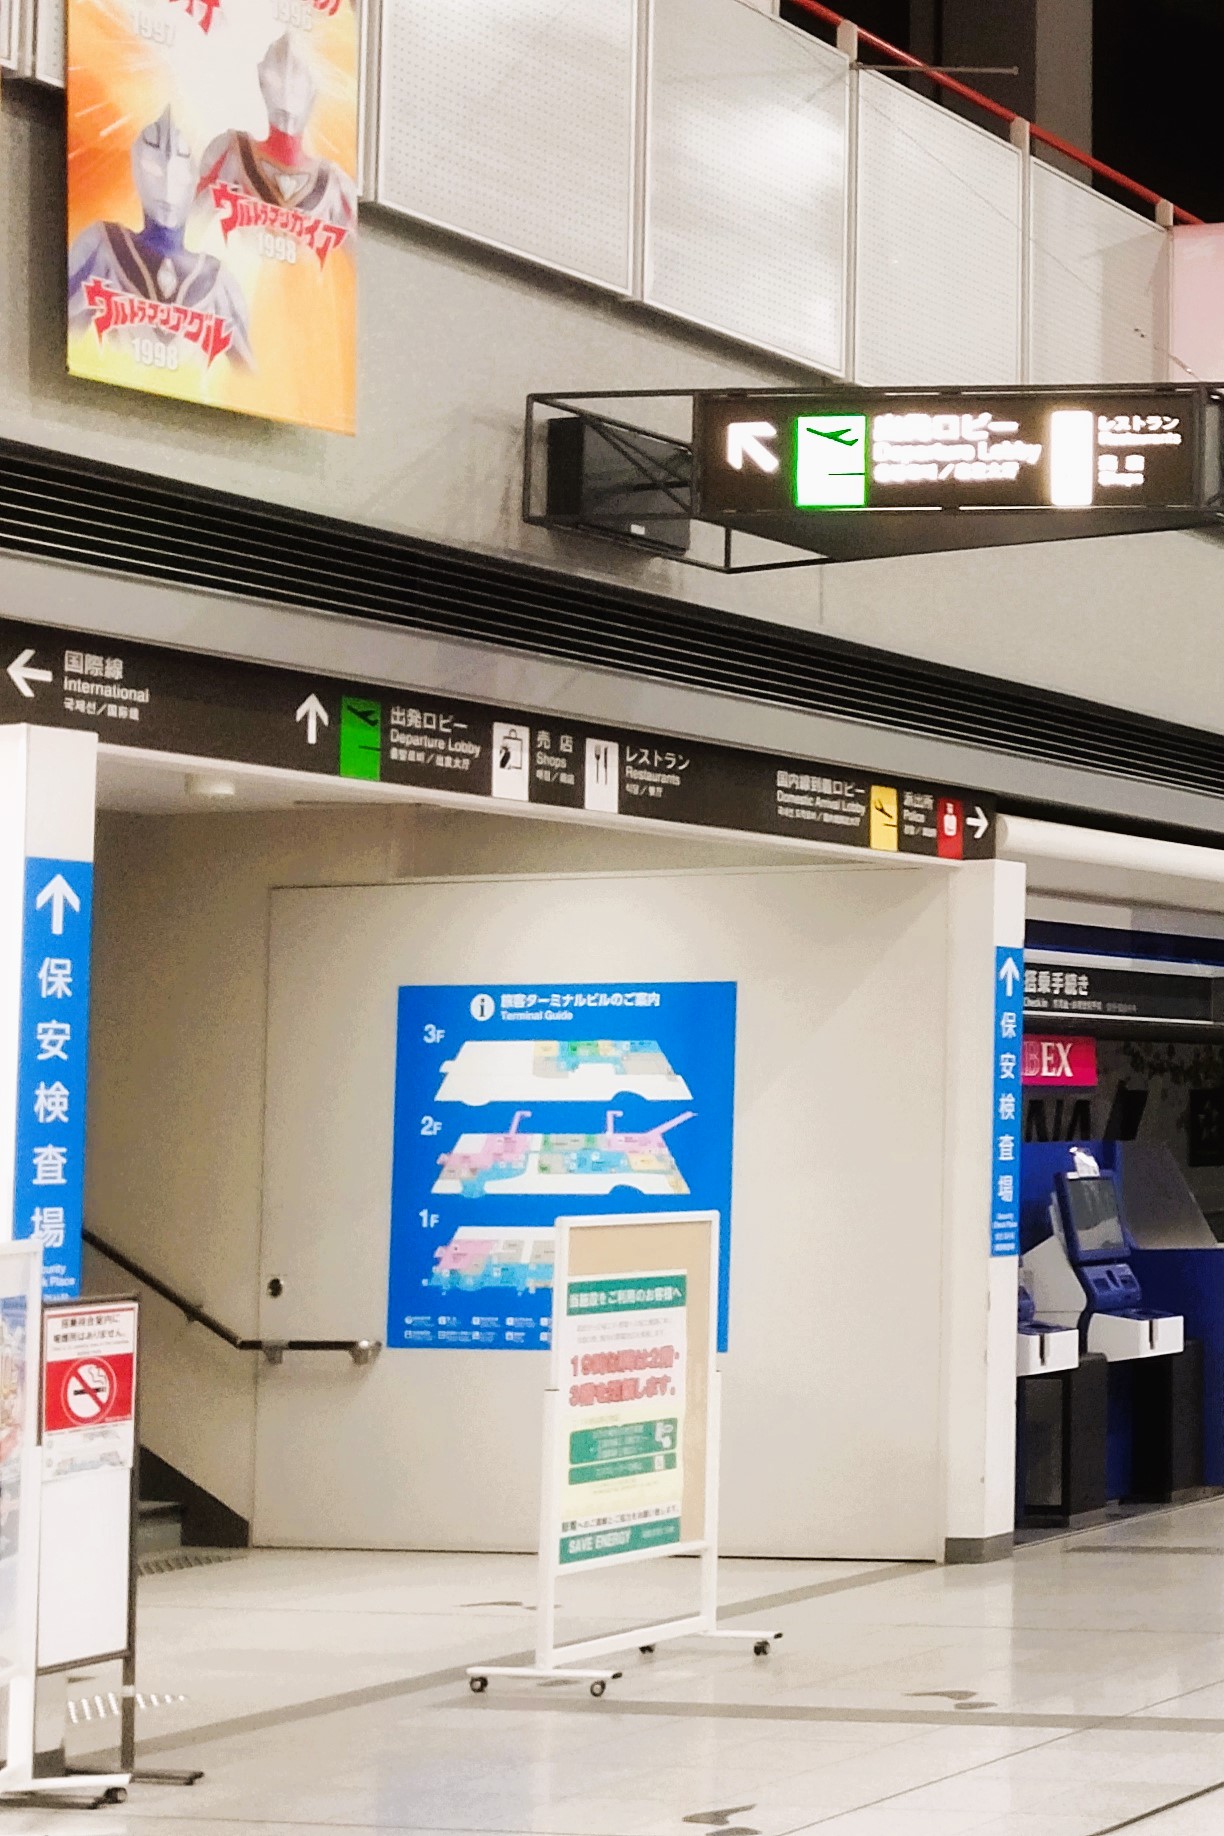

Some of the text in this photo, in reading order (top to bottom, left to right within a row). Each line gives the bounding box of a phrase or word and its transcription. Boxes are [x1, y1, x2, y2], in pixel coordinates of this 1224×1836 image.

[210, 181, 348, 272] ウルトラマンガイア
[257, 234, 297, 264] 1998
[83, 277, 234, 368] ウルトラマンアグル
[132, 337, 179, 370] 1998
[64, 650, 123, 680] 国際線
[64, 676, 149, 703] International
[390, 706, 468, 733] 出発ロビー
[390, 729, 482, 758] Departure Lobby
[535, 752, 567, 769] Shops
[626, 746, 690, 770] レストラン
[625, 766, 681, 786] Restaurants
[423, 1025, 446, 1043] 3F
[31, 957, 73, 1248] 保安検査場
[998, 1012, 1018, 1203] 保安検査場
[421, 1116, 442, 1136] 2F
[418, 1209, 440, 1228] 1F
